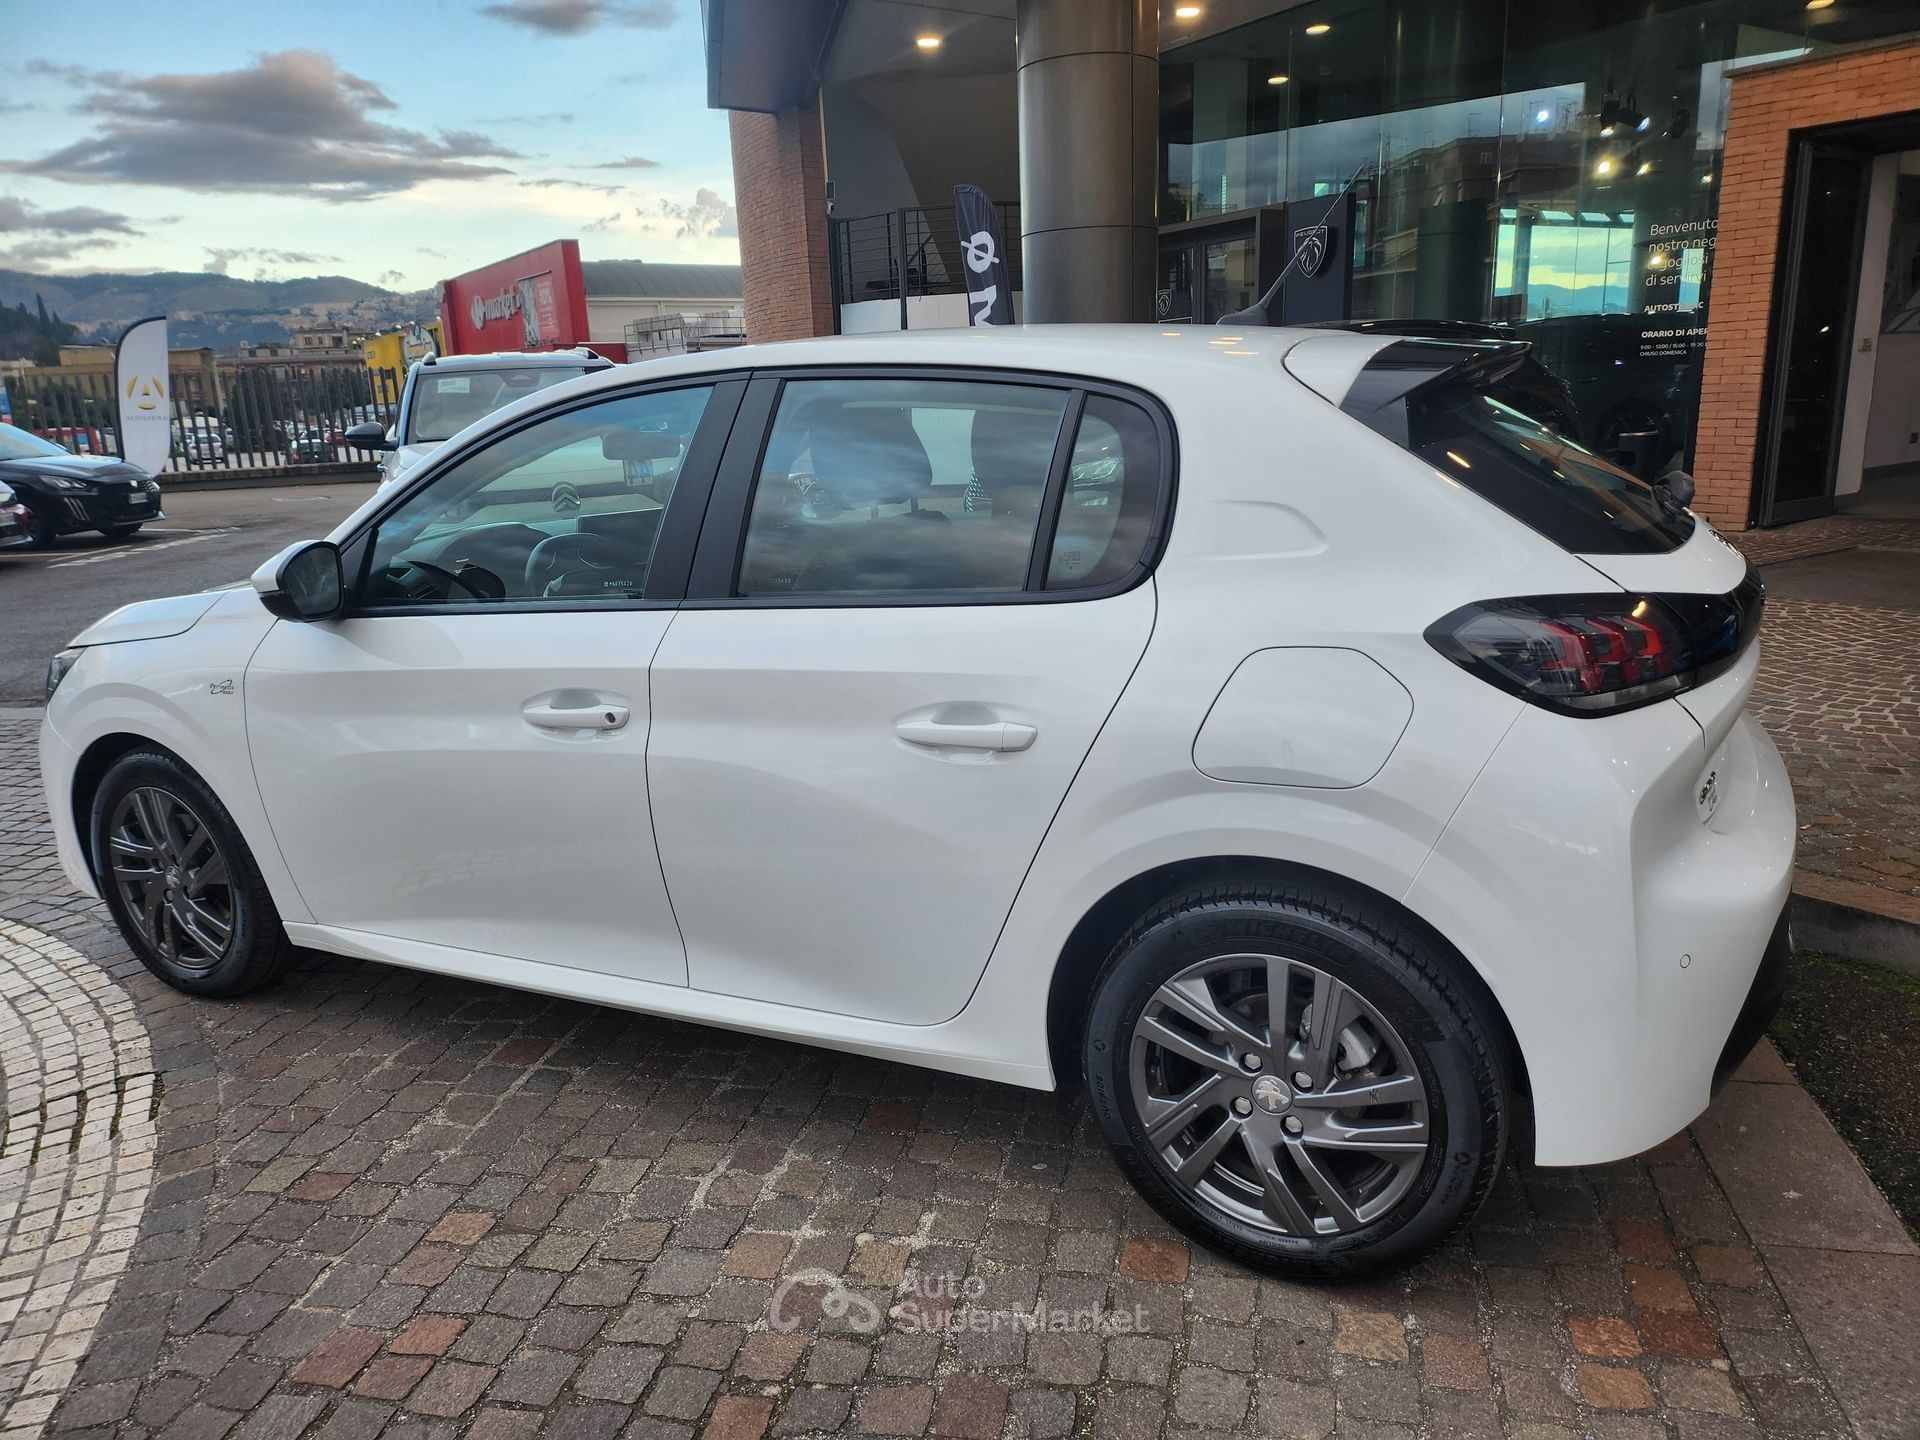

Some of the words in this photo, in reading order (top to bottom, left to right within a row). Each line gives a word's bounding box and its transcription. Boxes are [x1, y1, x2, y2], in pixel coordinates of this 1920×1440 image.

[1648, 239, 1689, 253] nostro
[1647, 252, 1709, 272] gogliosi
[1645, 274, 1657, 286] di
[1660, 270, 1707, 286] serirvi
[1641, 329, 1674, 338] ORARIO
[1675, 329, 1685, 337] DI
